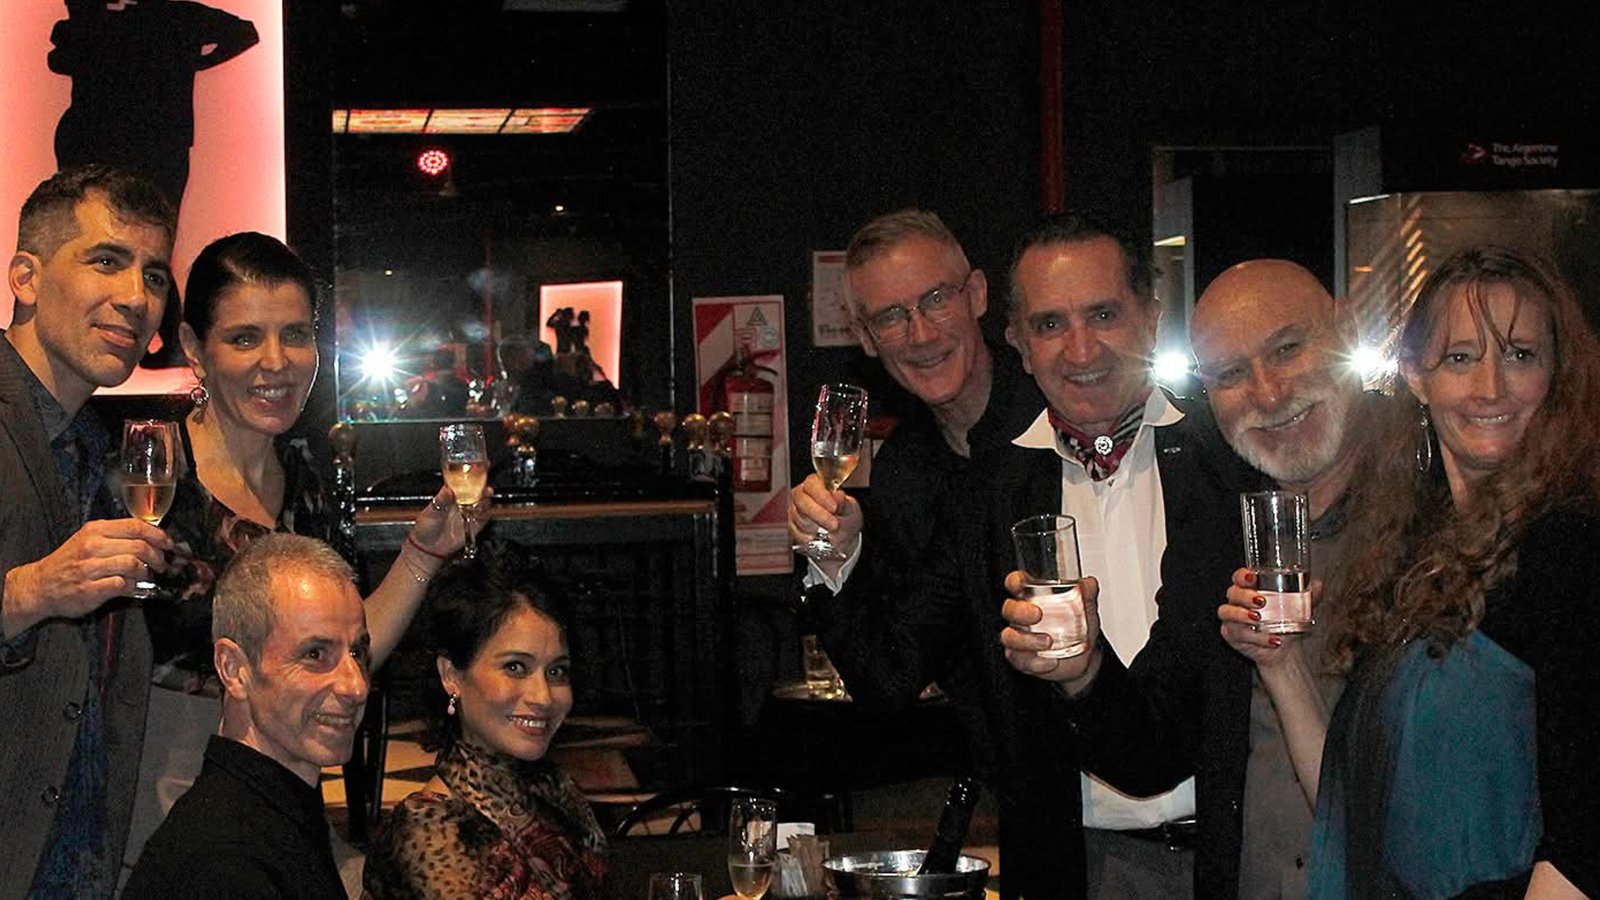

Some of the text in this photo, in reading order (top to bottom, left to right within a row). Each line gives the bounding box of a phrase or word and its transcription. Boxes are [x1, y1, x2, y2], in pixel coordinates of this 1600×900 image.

[1491, 142, 1509, 153] The
[1491, 154, 1559, 168] Tango Society
